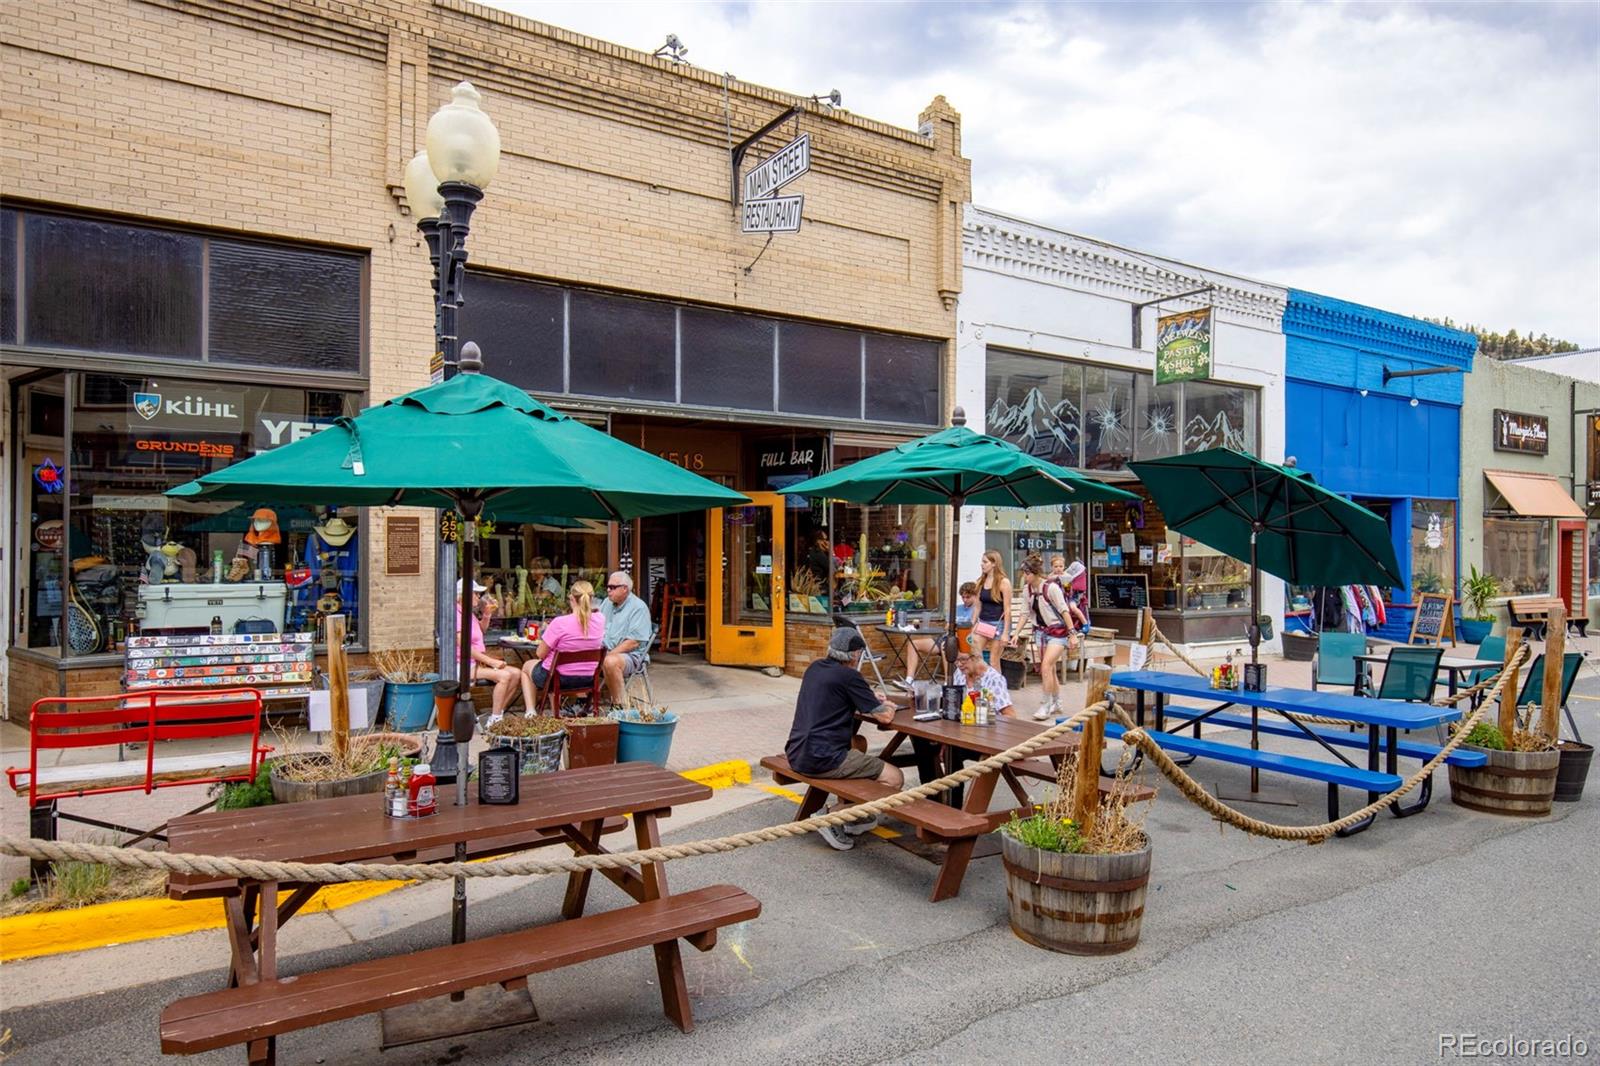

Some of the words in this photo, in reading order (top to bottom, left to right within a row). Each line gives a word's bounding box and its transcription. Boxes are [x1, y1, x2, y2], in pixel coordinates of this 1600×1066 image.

[749, 163, 770, 198] MAIN
[772, 141, 805, 185] STREET
[745, 201, 799, 229] RESTAURANT
[1158, 329, 1210, 350] EDELWEISS
[1163, 344, 1201, 360] PASTRY
[1169, 358, 1196, 370] SHOP
[166, 396, 238, 418] KÜHL
[760, 451, 786, 467] FULL
[790, 449, 814, 465] BAR
[441, 520, 457, 531] 25
[442, 531, 457, 541] 79
[1020, 538, 1052, 549] SHOP
